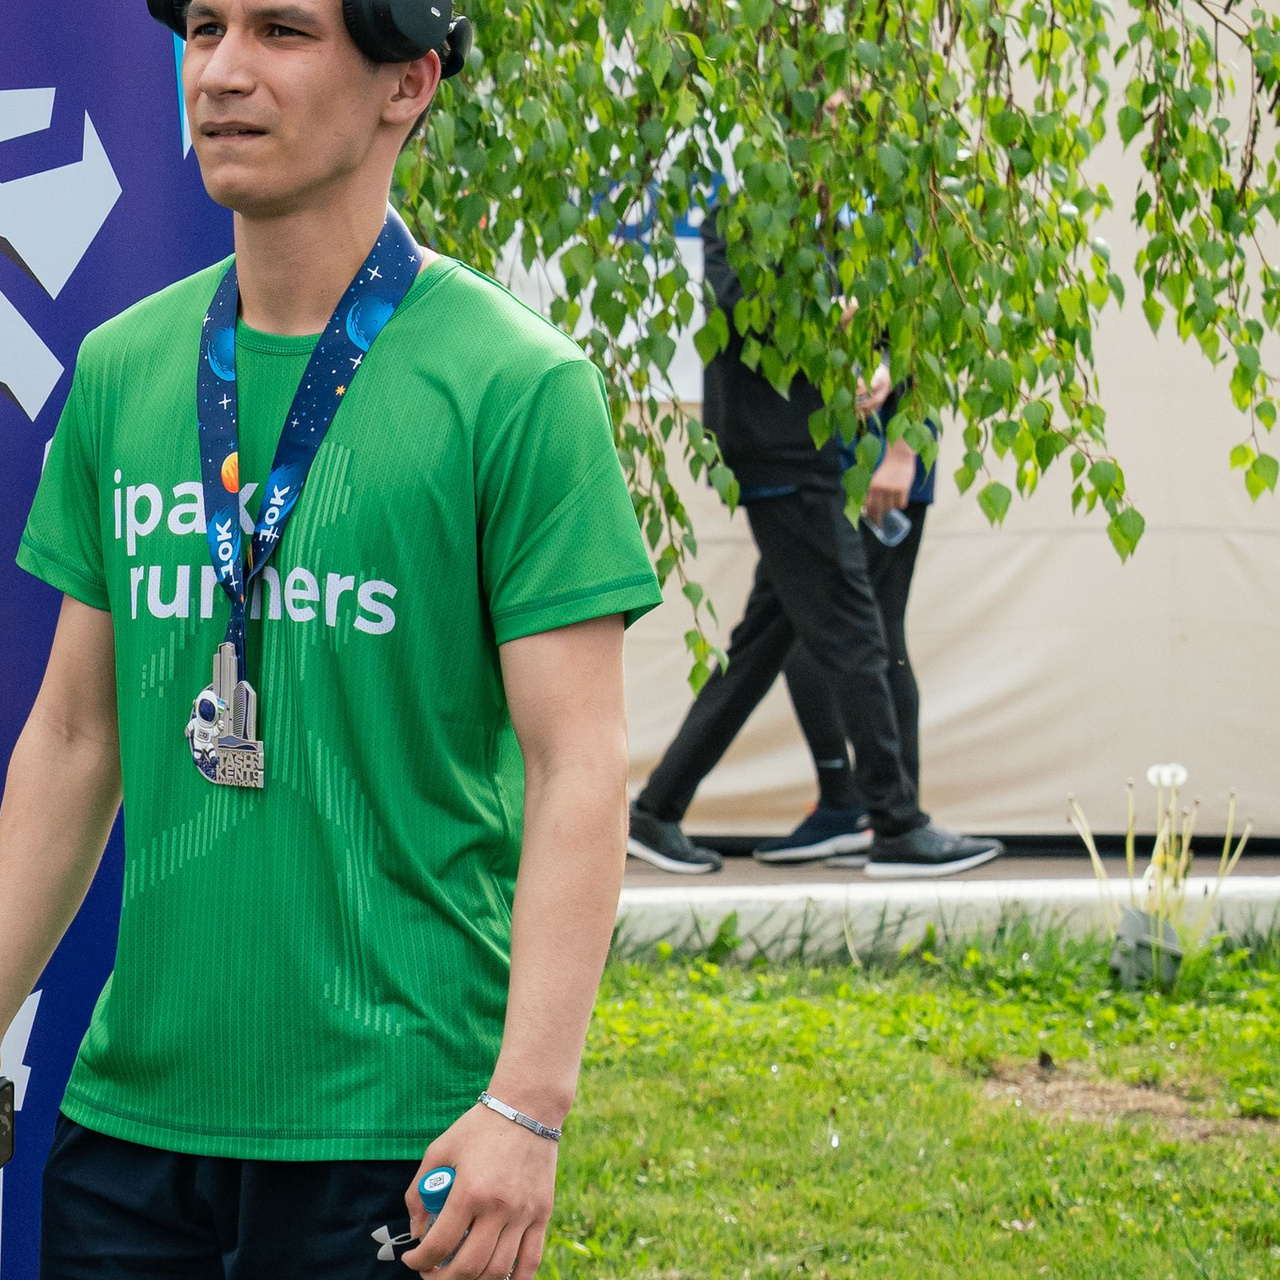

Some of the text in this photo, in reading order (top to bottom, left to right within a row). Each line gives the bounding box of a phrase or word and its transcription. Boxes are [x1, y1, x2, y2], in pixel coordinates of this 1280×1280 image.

[259, 485, 291, 542] 10K
[216, 518, 234, 579] 10K
[216, 765, 253, 781] KENT
